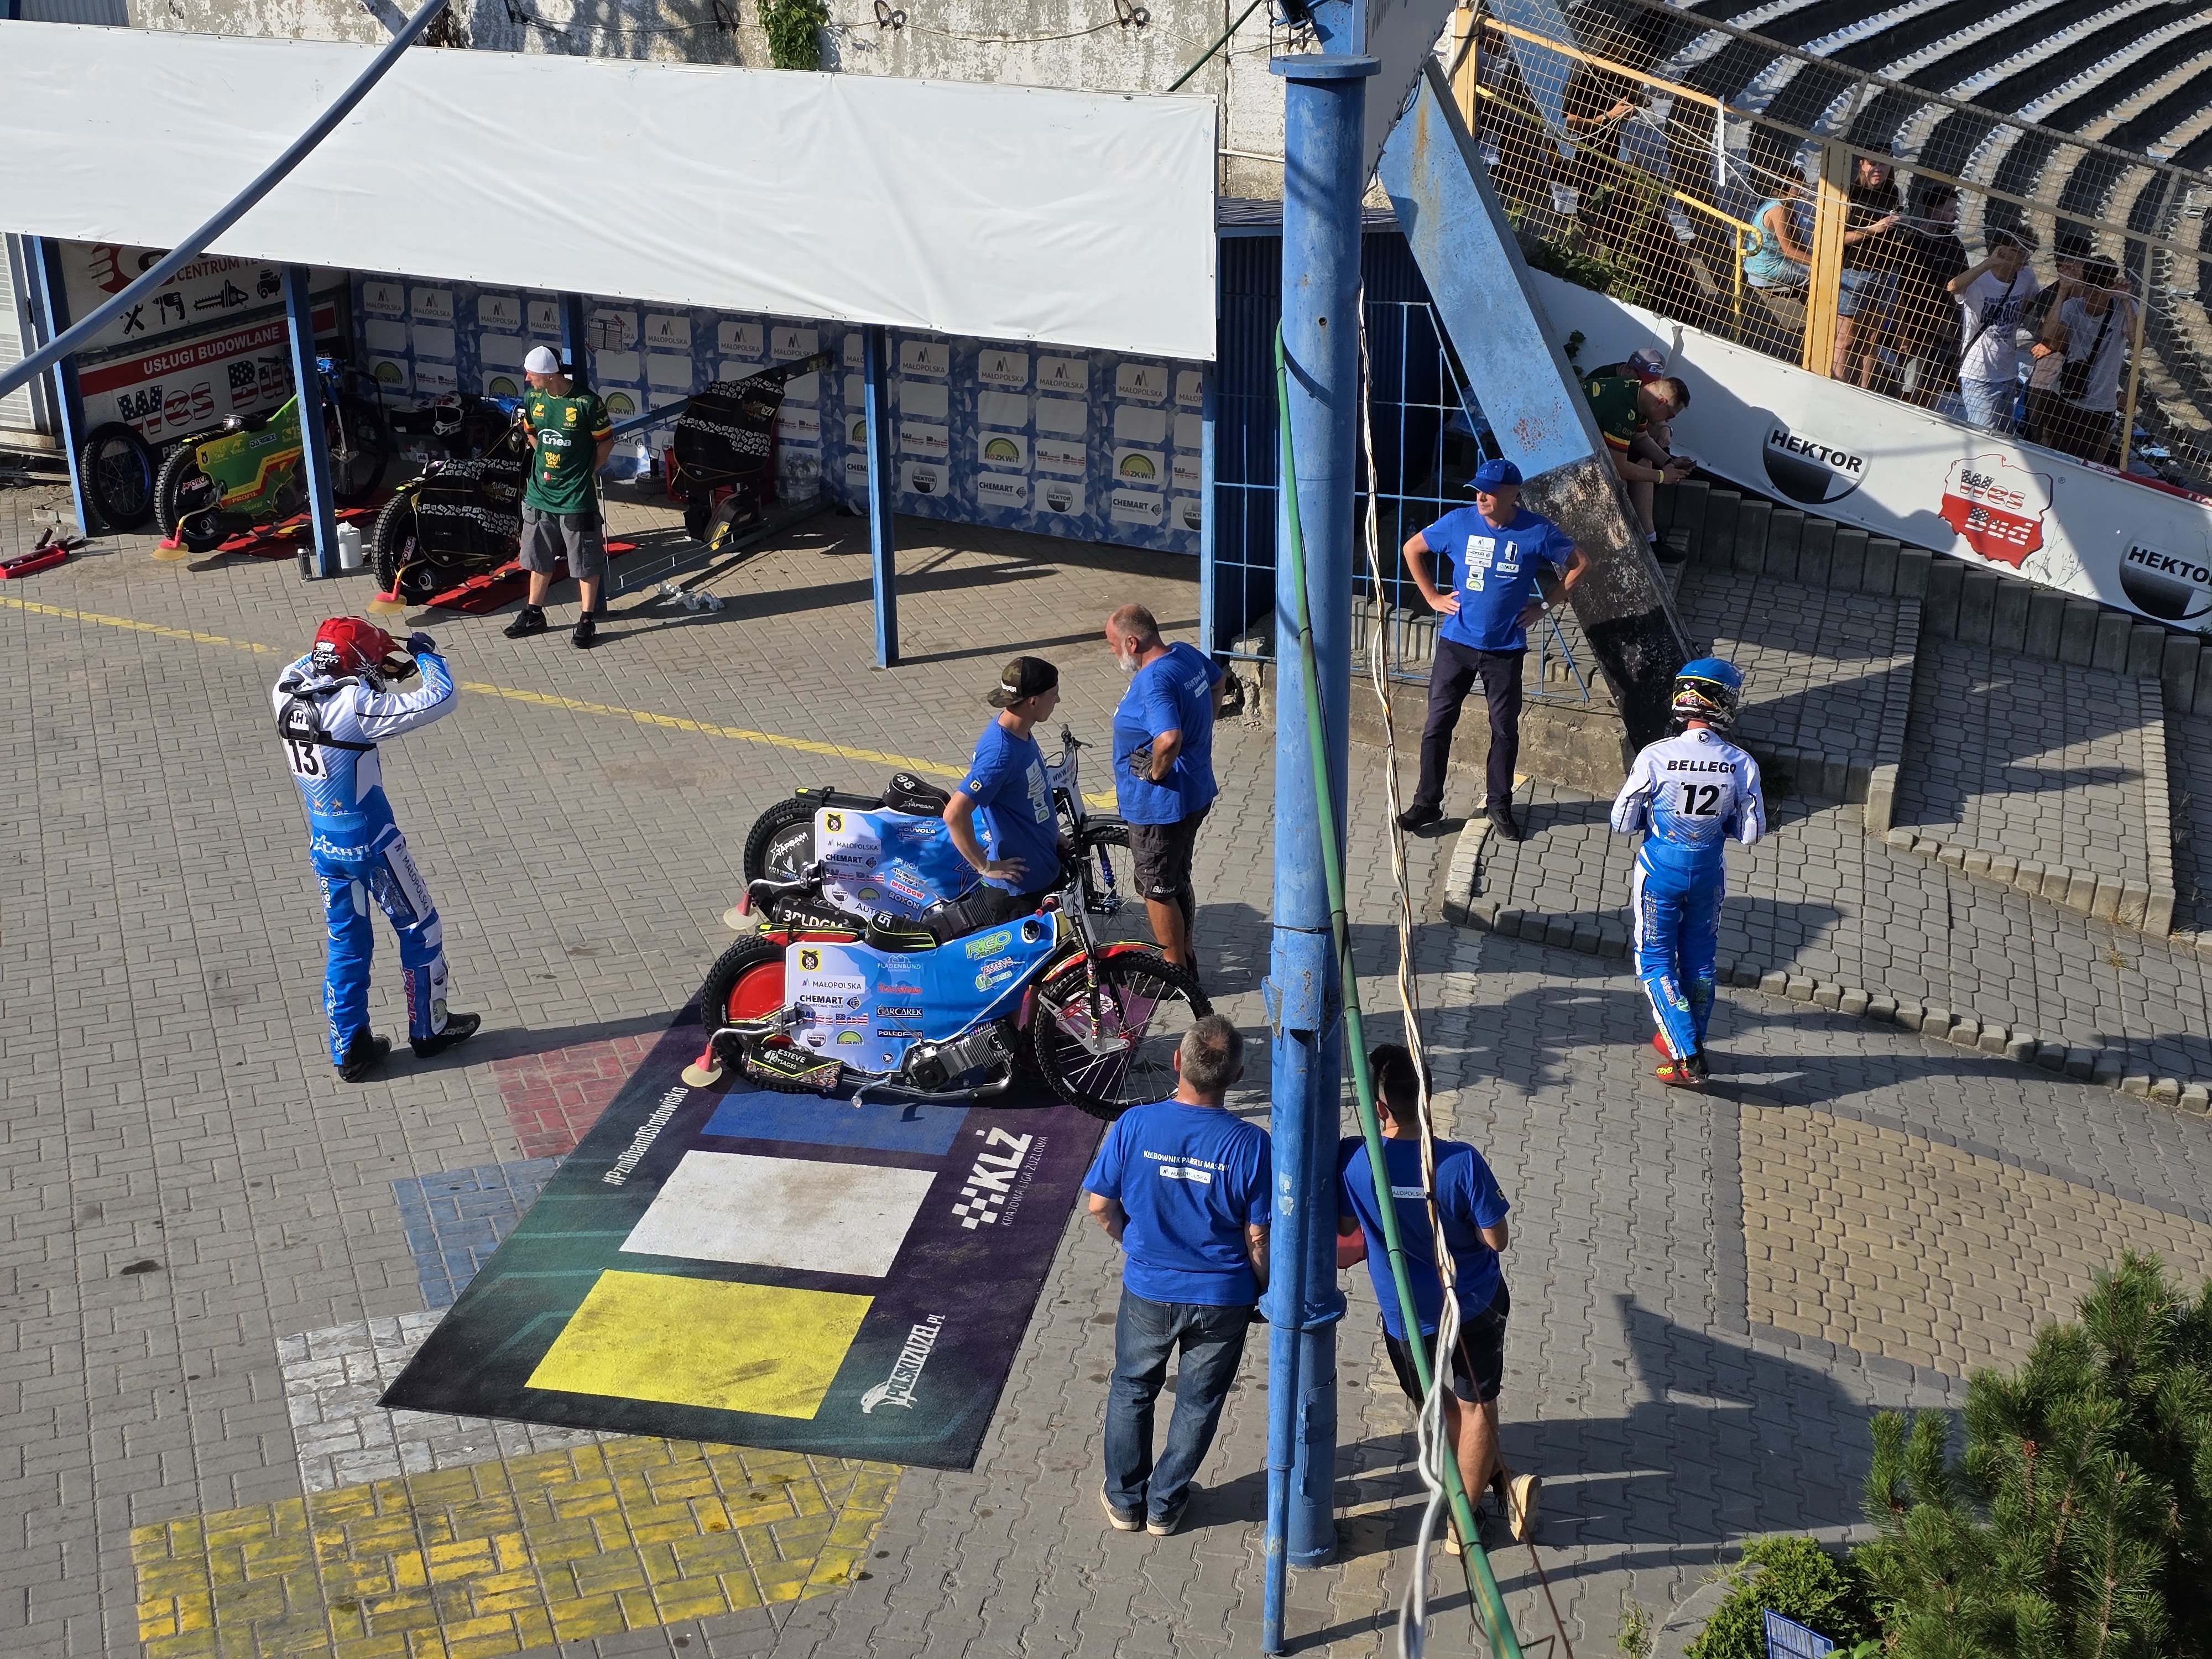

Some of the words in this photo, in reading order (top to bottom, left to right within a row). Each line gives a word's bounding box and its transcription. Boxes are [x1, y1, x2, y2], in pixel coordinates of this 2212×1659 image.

[176, 257, 239, 281] CENTRUM
[530, 321, 560, 331] MAŁOPOLS
[144, 352, 194, 374] USŁUGI
[199, 326, 280, 359] BUDOWLANE
[902, 363, 945, 373] MAŁOPOLSKA
[981, 371, 1024, 383] MAŁOPOLSKA
[1039, 379, 1084, 389] MAŁOPOLSKA
[117, 367, 215, 436] Wes
[227, 359, 285, 409] Bu
[1119, 385, 1162, 398] MAŁOPOLSKA
[542, 434, 572, 446] Enea
[1770, 429, 1862, 472] HEKTOR
[979, 482, 1013, 492] CHEMART
[1960, 469, 2026, 510] Wes
[1113, 499, 1148, 509] CHEMART
[1965, 508, 2033, 546] Bud
[288, 740, 319, 775] 13
[1667, 760, 1736, 774] BELLEGO
[1683, 784, 1720, 816] 12
[836, 841, 879, 851] MAŁOPOLSKA
[826, 854, 863, 863] CHEMART
[402, 855, 429, 914] MAŁOPOLSKA
[891, 880, 924, 899] MOLDOW
[888, 891, 920, 910] ROXON
[812, 980, 862, 989] MAŁOPOLSKA
[800, 995, 843, 1004] CHEMART
[877, 1008, 922, 1016] GARCAREK
[778, 1049, 806, 1063] ESTEVE
[967, 1127, 1034, 1193] KLŻ
[1144, 1150, 1181, 1164] KIEROWNIK
